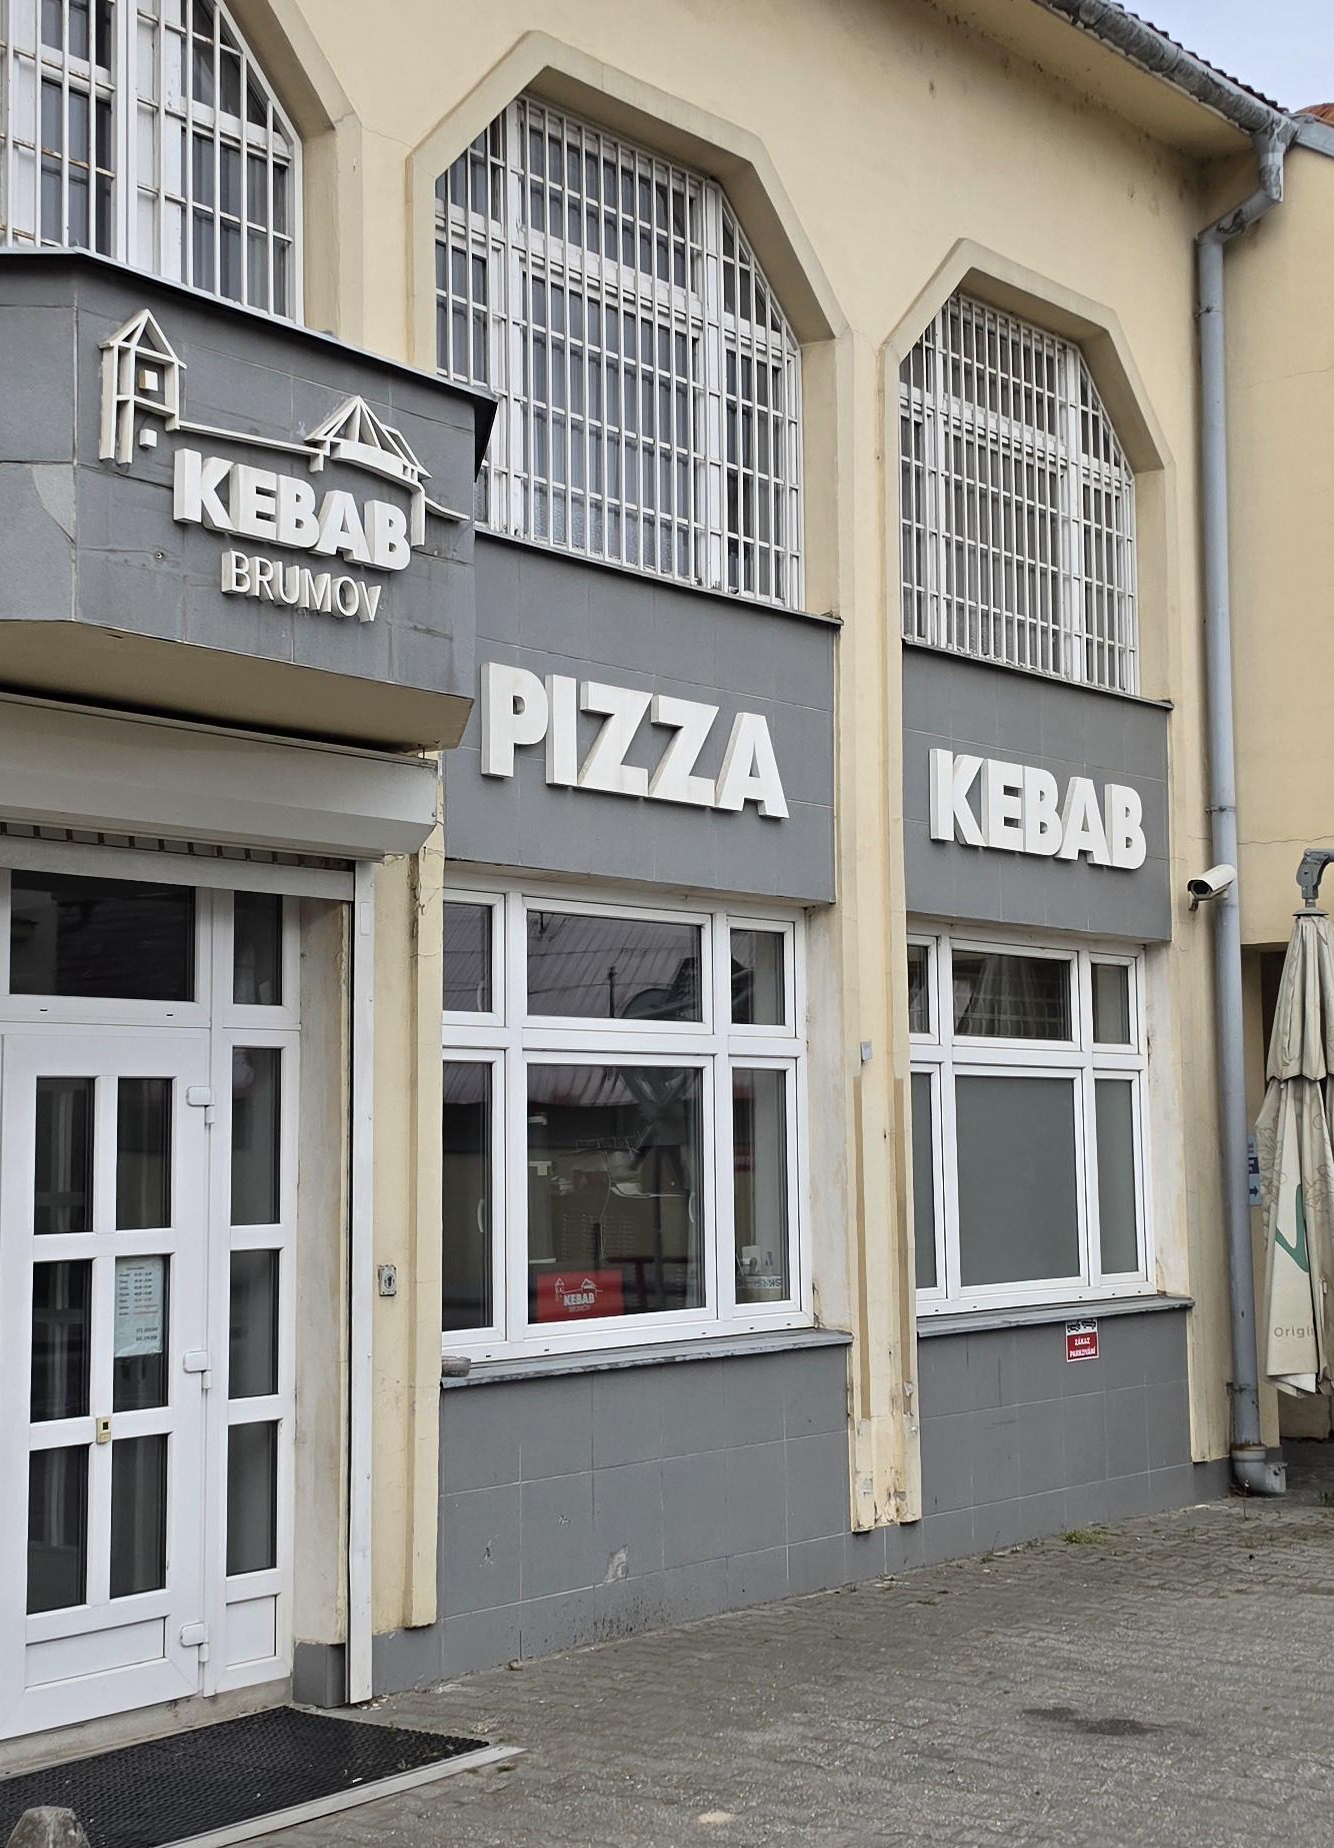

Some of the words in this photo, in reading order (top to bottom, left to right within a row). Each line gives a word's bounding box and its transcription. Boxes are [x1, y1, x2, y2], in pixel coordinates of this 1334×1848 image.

[174, 449, 410, 571] KEBAB
[222, 550, 381, 622] BRUMOV
[481, 662, 789, 819] PIZZA
[930, 749, 1146, 869] KEBAB
